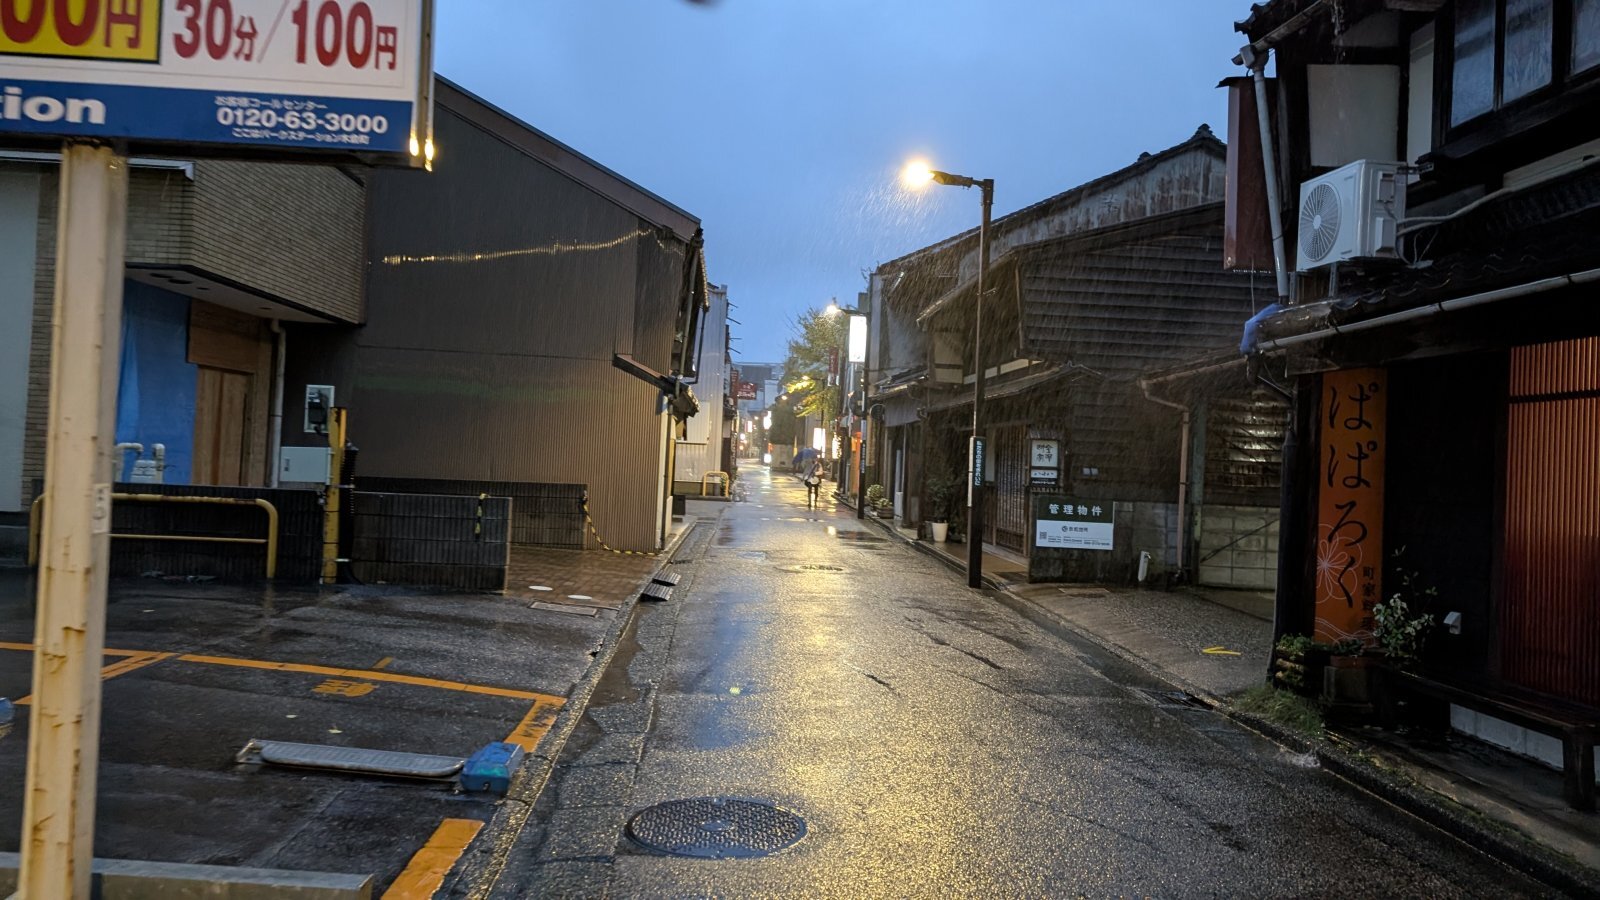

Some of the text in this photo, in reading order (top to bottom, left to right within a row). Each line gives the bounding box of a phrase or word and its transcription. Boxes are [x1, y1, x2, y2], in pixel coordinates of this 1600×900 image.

[0, 86, 106, 125] ion
[216, 107, 388, 135] 0120-63-3000
[1048, 503, 1102, 517] 管理物件
[1327, 381, 1379, 609] ぱぱろく
